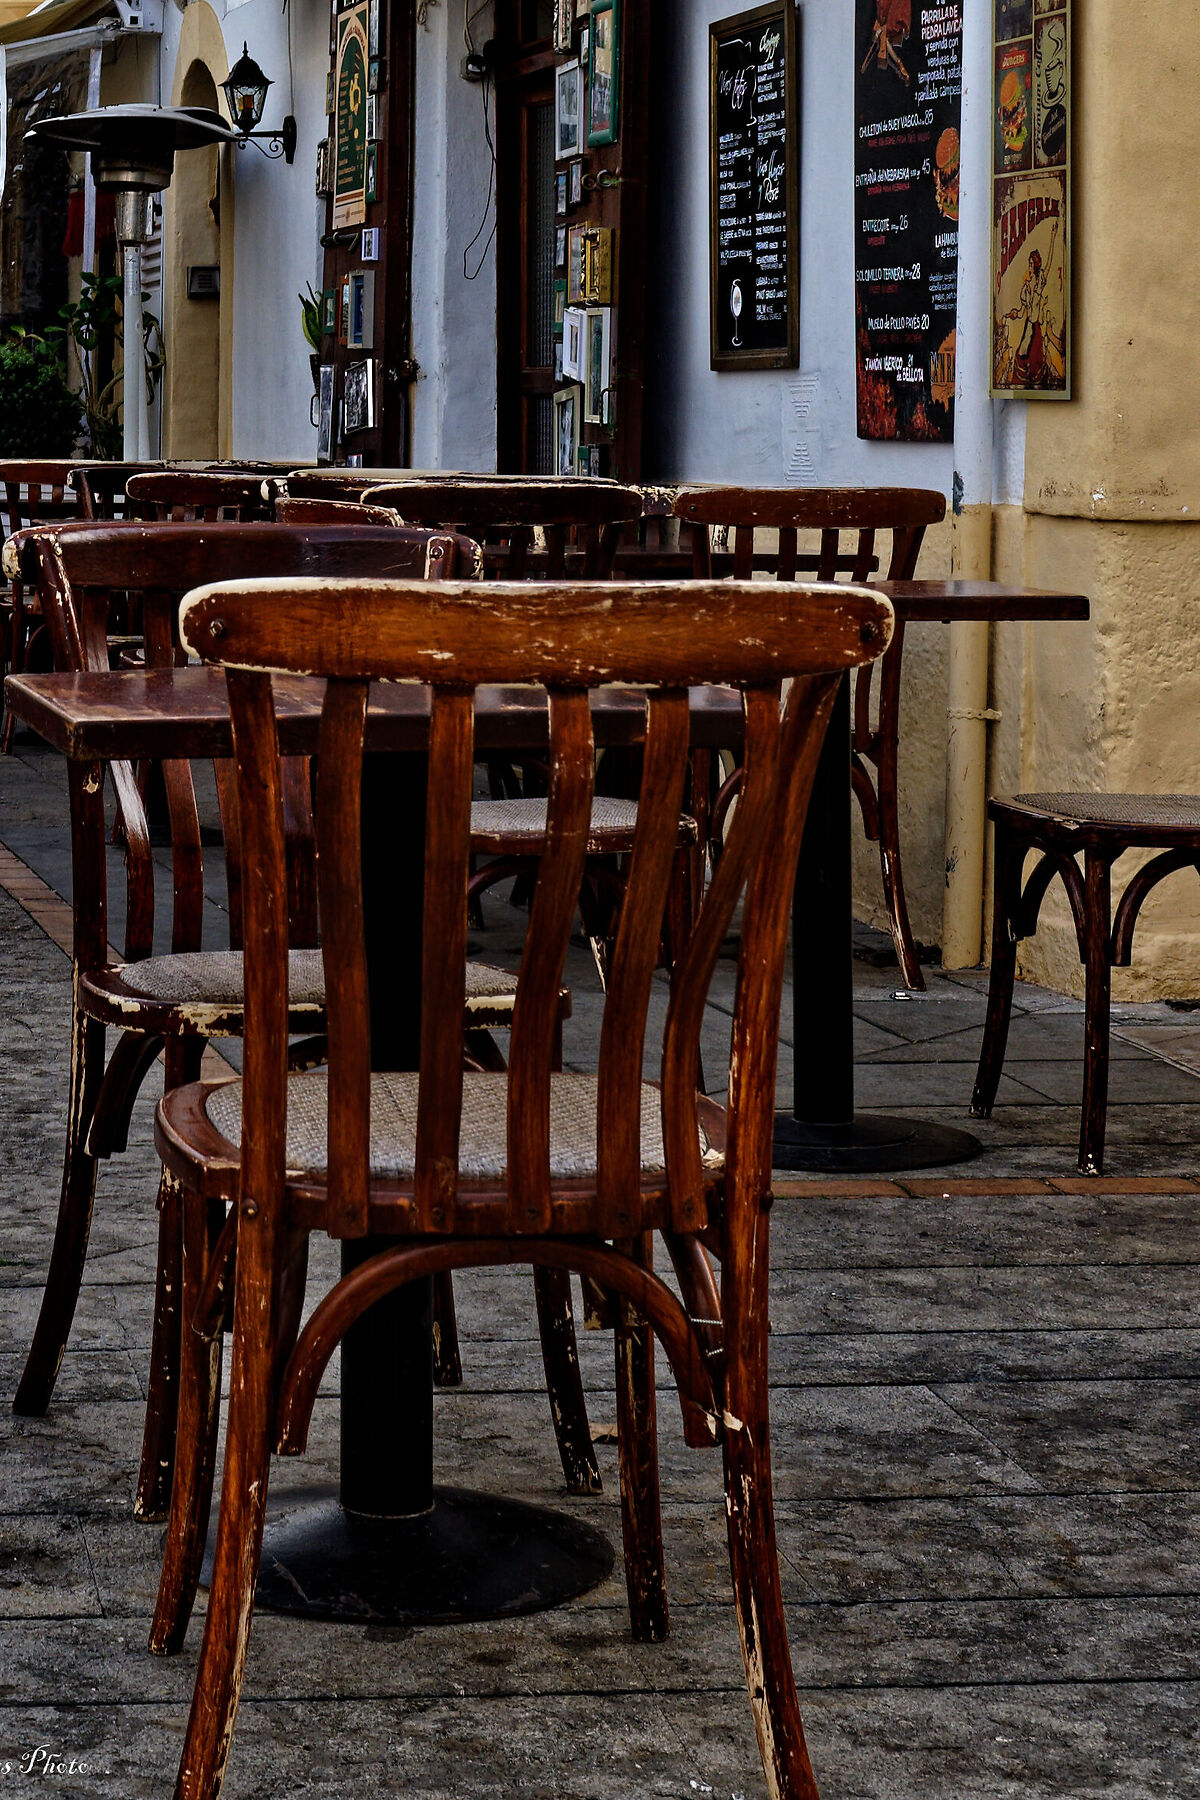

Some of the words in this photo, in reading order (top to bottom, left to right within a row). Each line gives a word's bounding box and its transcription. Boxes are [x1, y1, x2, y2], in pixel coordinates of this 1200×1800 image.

[924, 108, 934, 126] 85
[921, 158, 931, 175] 45
[899, 214, 908, 231] 26
[911, 262, 921, 280] 28
[920, 313, 930, 330] 20
